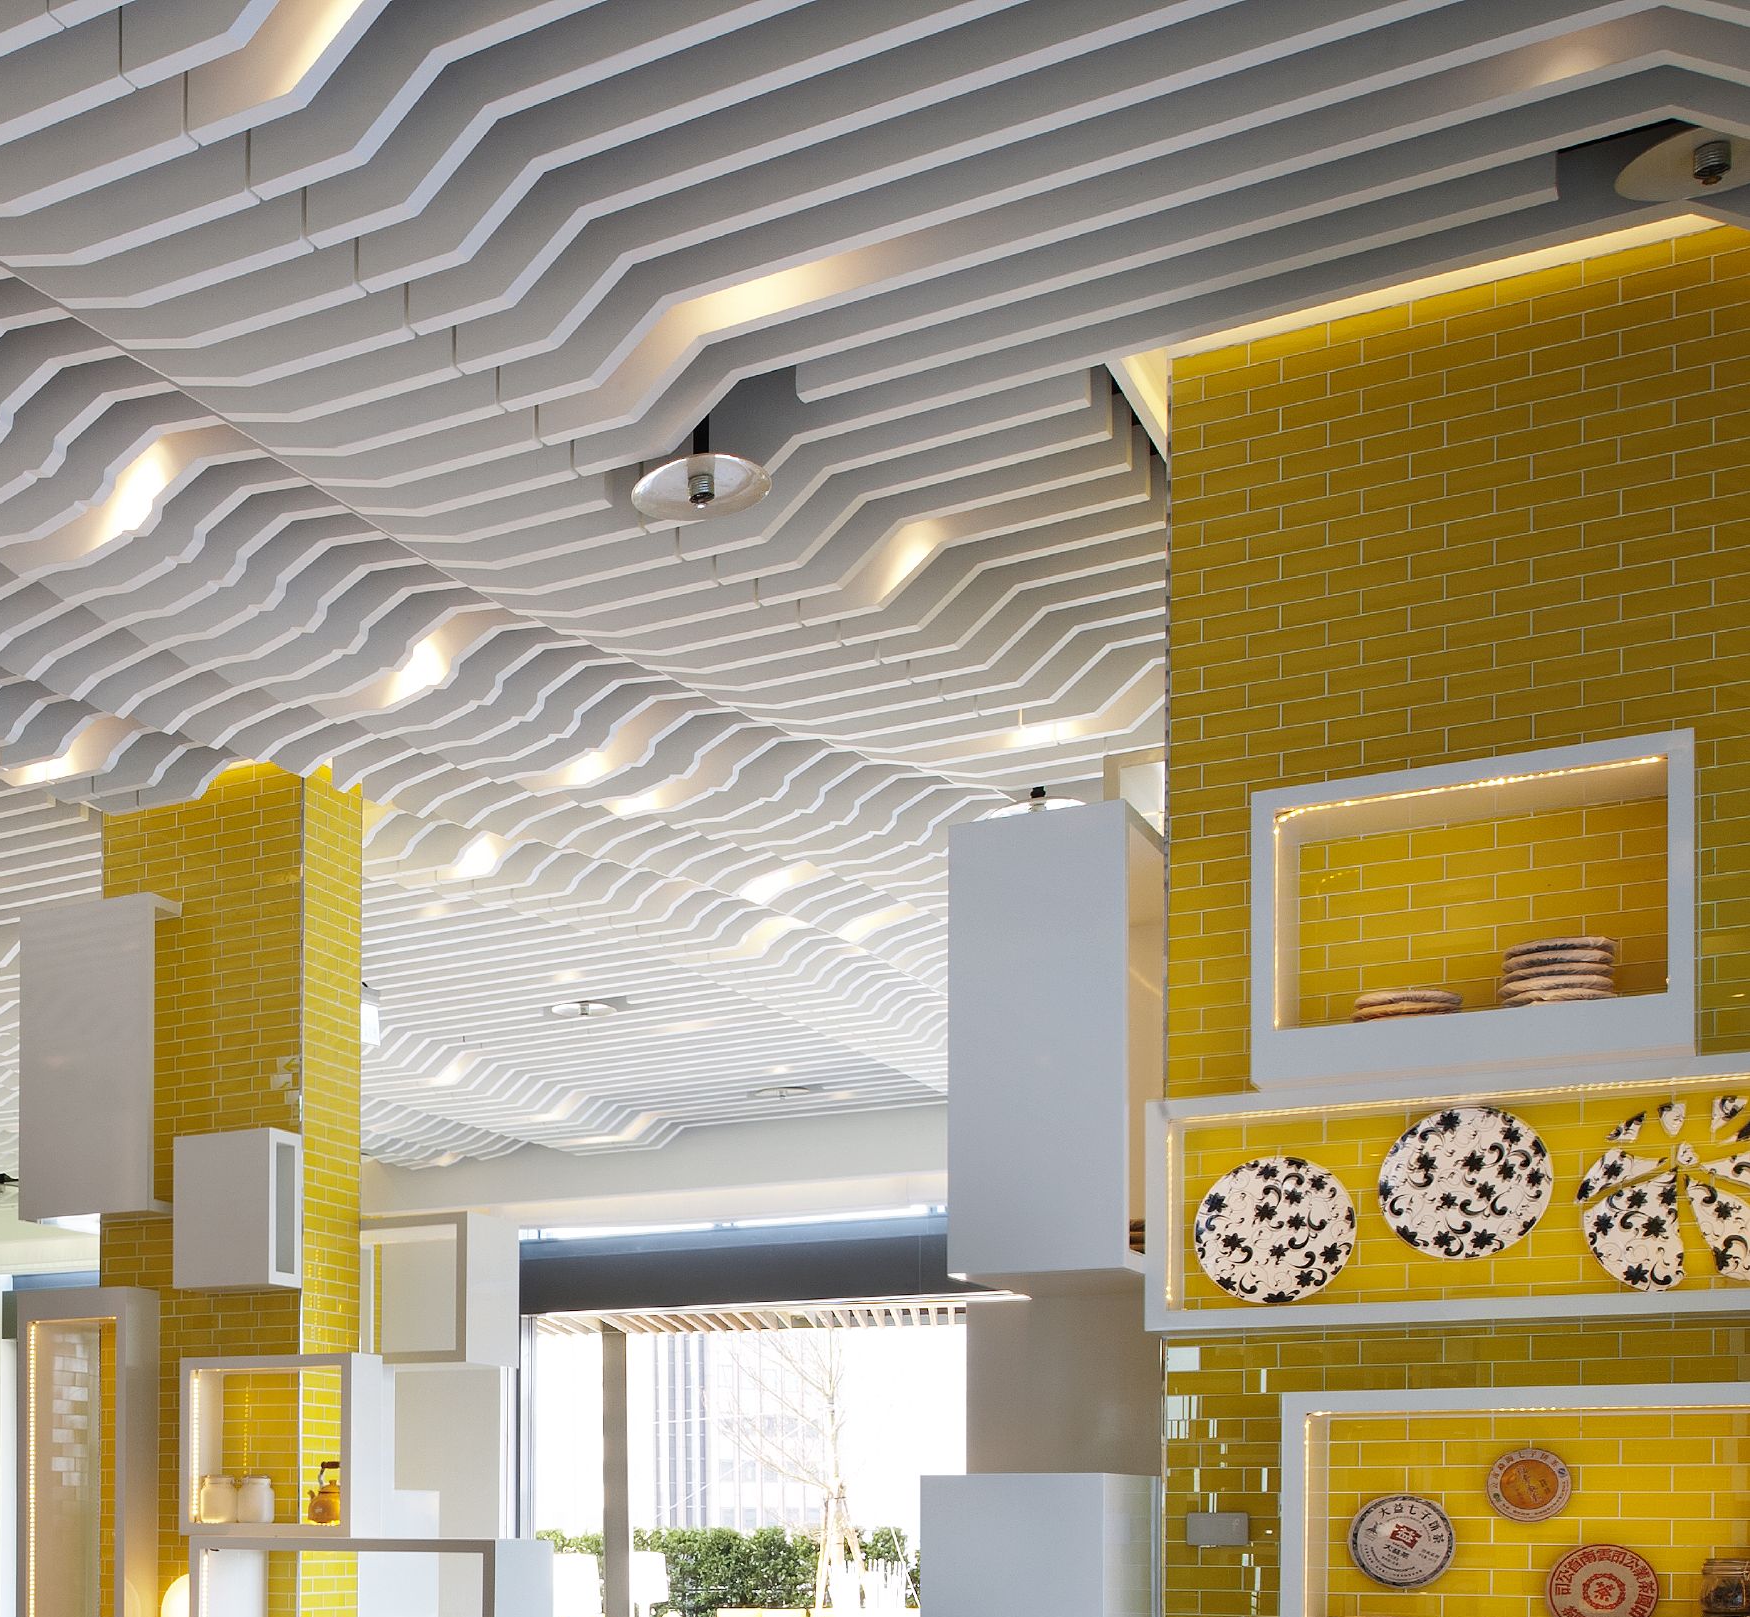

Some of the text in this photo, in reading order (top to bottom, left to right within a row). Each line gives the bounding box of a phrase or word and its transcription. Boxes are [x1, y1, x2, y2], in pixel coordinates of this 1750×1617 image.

[1378, 1502, 1445, 1544] 大益七子饼茶
